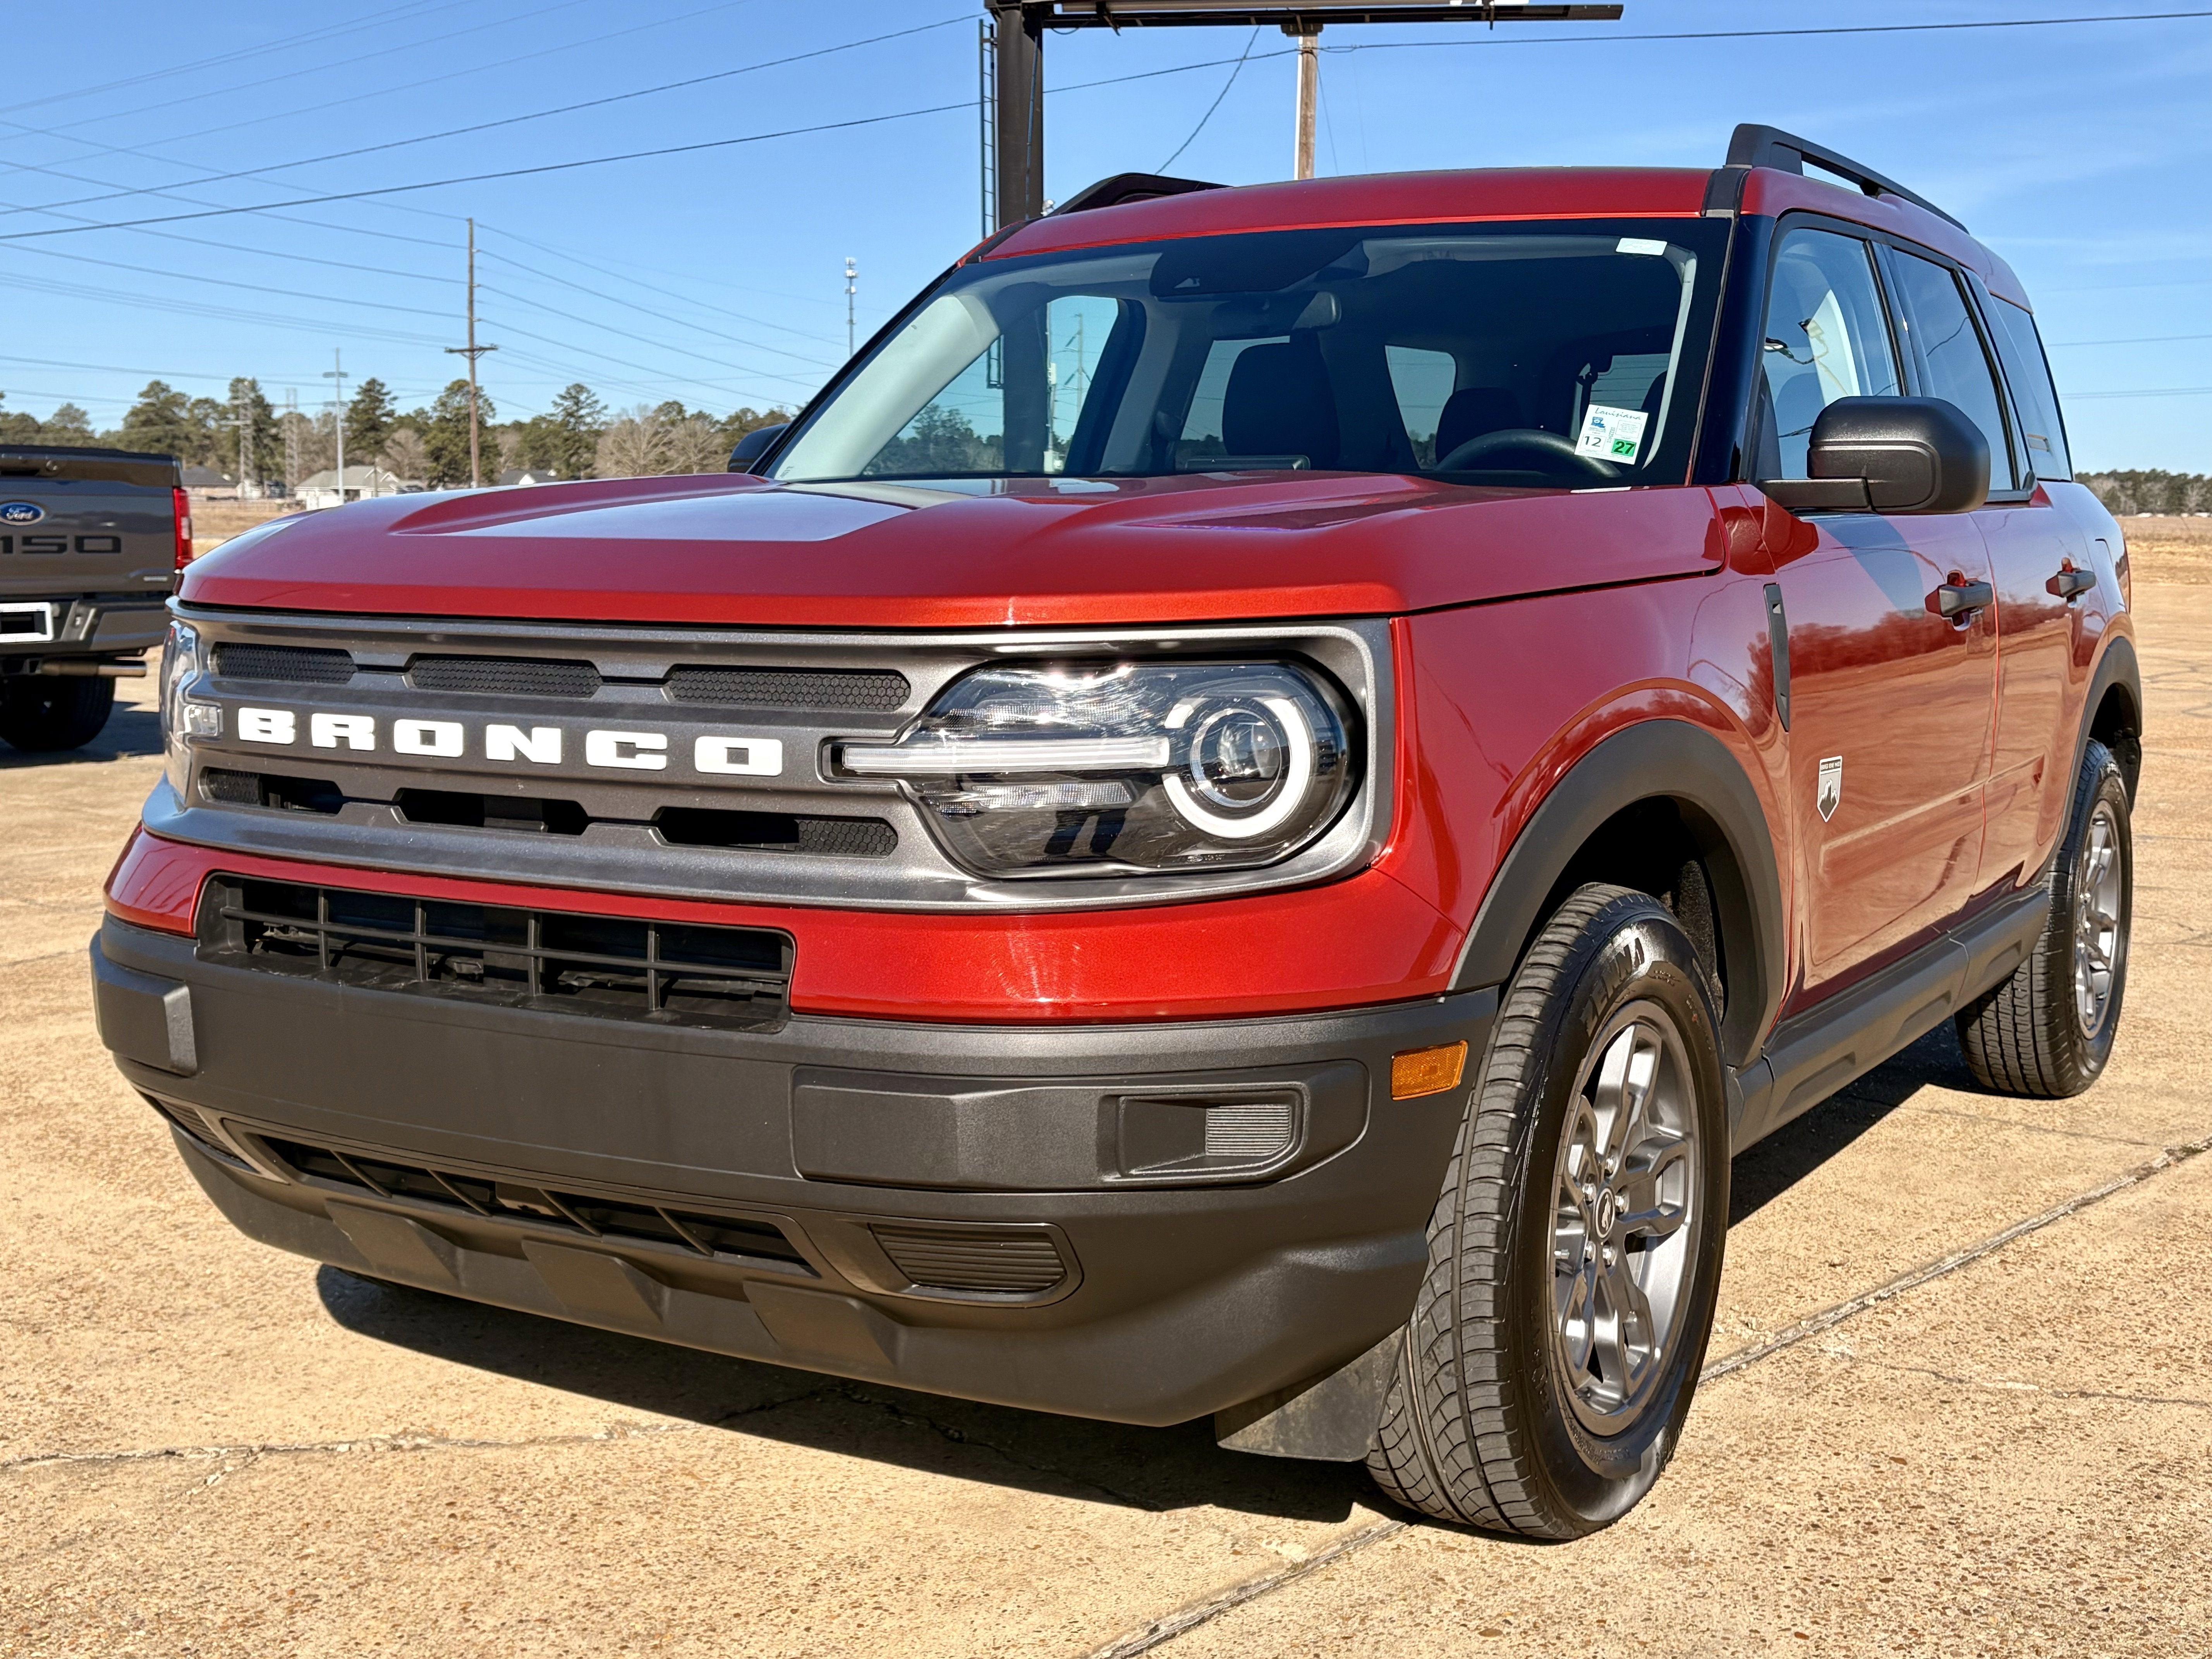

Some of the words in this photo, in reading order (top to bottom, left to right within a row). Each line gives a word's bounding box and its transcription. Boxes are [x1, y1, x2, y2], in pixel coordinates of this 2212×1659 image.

[1595, 407, 1641, 420] Louisiana
[1585, 436, 1601, 447] 12
[1613, 441, 1635, 454] 27
[6, 507, 34, 520] Ford
[238, 707, 783, 776] BRONCO
